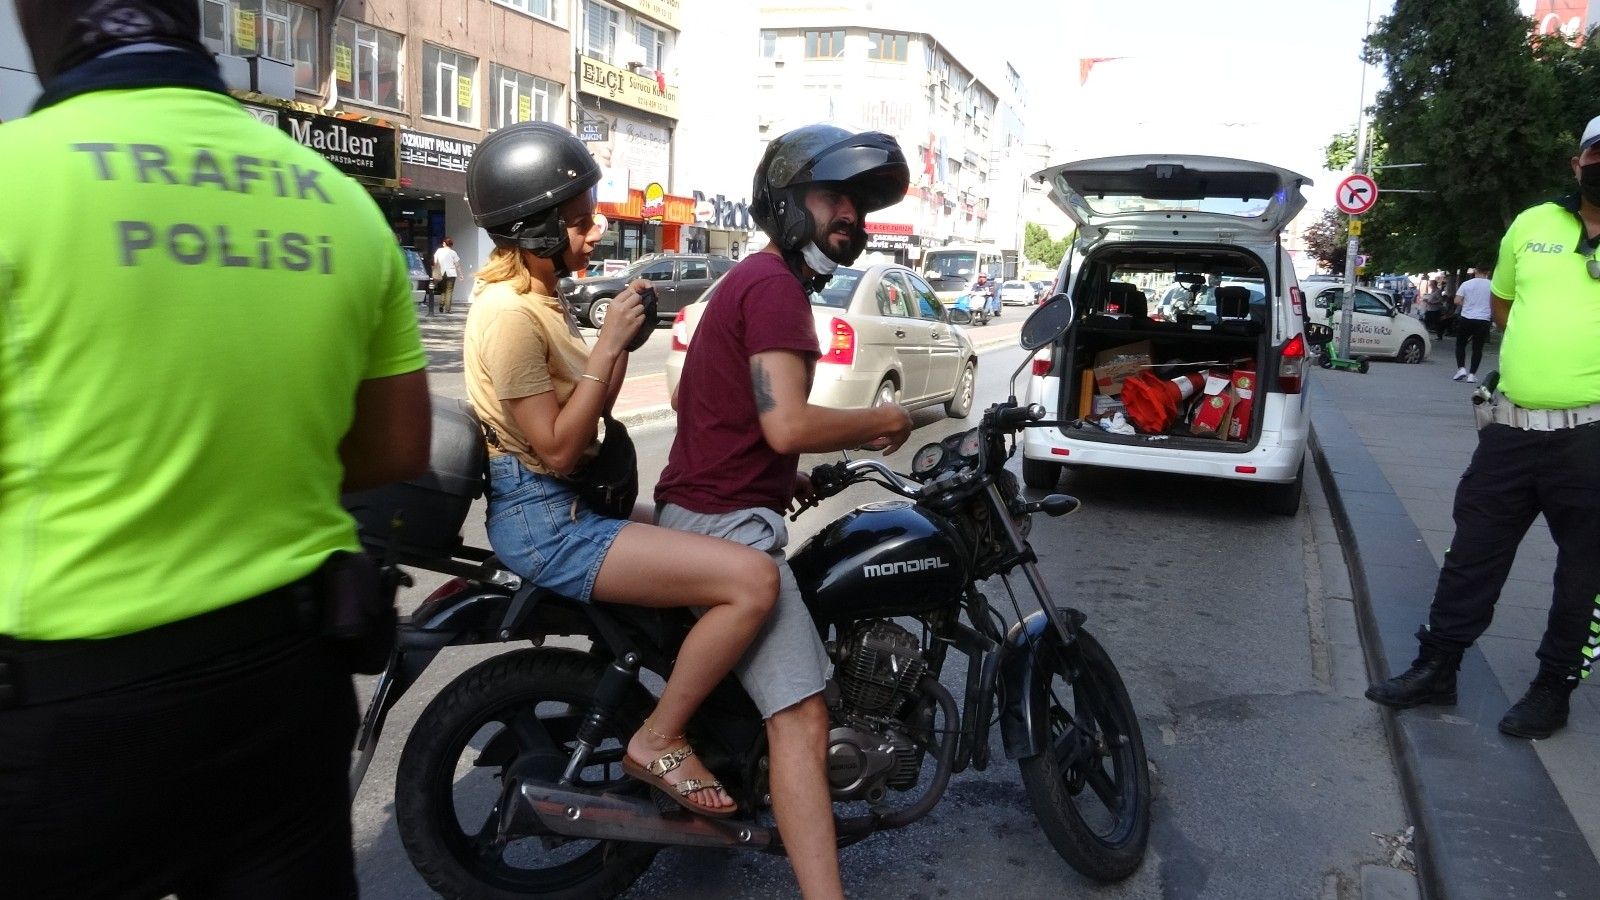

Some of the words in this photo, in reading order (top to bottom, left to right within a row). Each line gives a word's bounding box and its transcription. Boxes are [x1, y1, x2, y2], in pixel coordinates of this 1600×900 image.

[583, 62, 625, 97] ELÇİ
[288, 118, 375, 157] Madlen
[400, 132, 435, 151] OZKURT
[864, 557, 949, 578] MONDIAL
